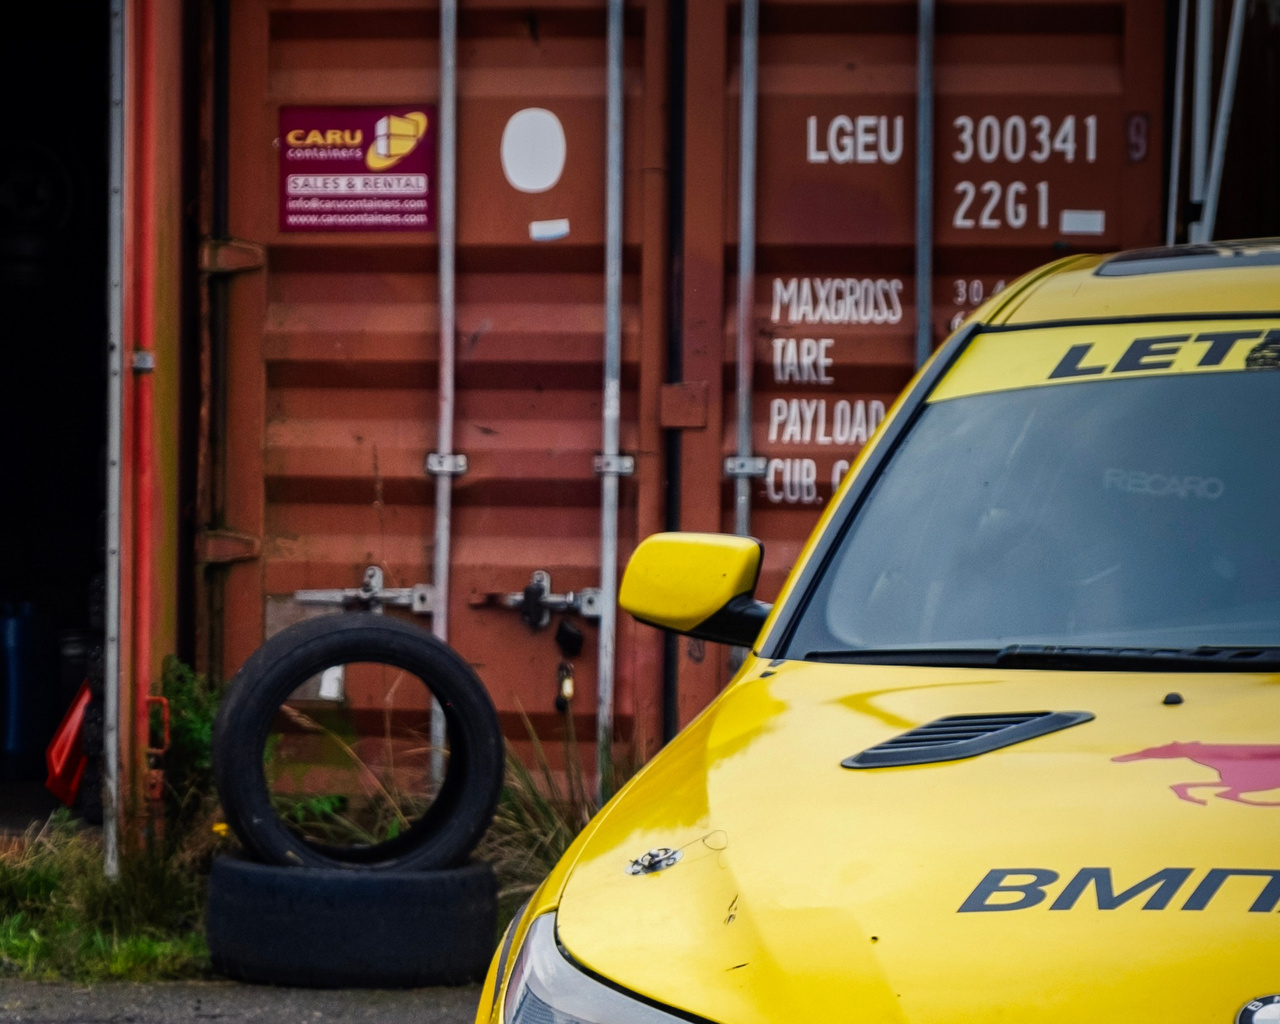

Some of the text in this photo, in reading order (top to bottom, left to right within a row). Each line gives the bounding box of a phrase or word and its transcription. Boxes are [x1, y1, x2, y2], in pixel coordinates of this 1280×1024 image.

[286, 129, 363, 146] CARU
[286, 146, 363, 159] containers
[807, 115, 904, 164] LGEU
[952, 115, 1097, 163] 300341
[288, 198, 427, 210] info@carucontainers.com
[291, 177, 424, 189] SALES & RENTAL
[952, 180, 1049, 229] 22G1
[288, 212, 427, 224] www.carucontainers.com
[771, 277, 903, 324] MAXGROSS
[773, 338, 835, 384] TARE
[768, 398, 886, 445] PAYLOAD
[766, 458, 823, 501] CUB.
[956, 867, 1280, 913] ВМП
